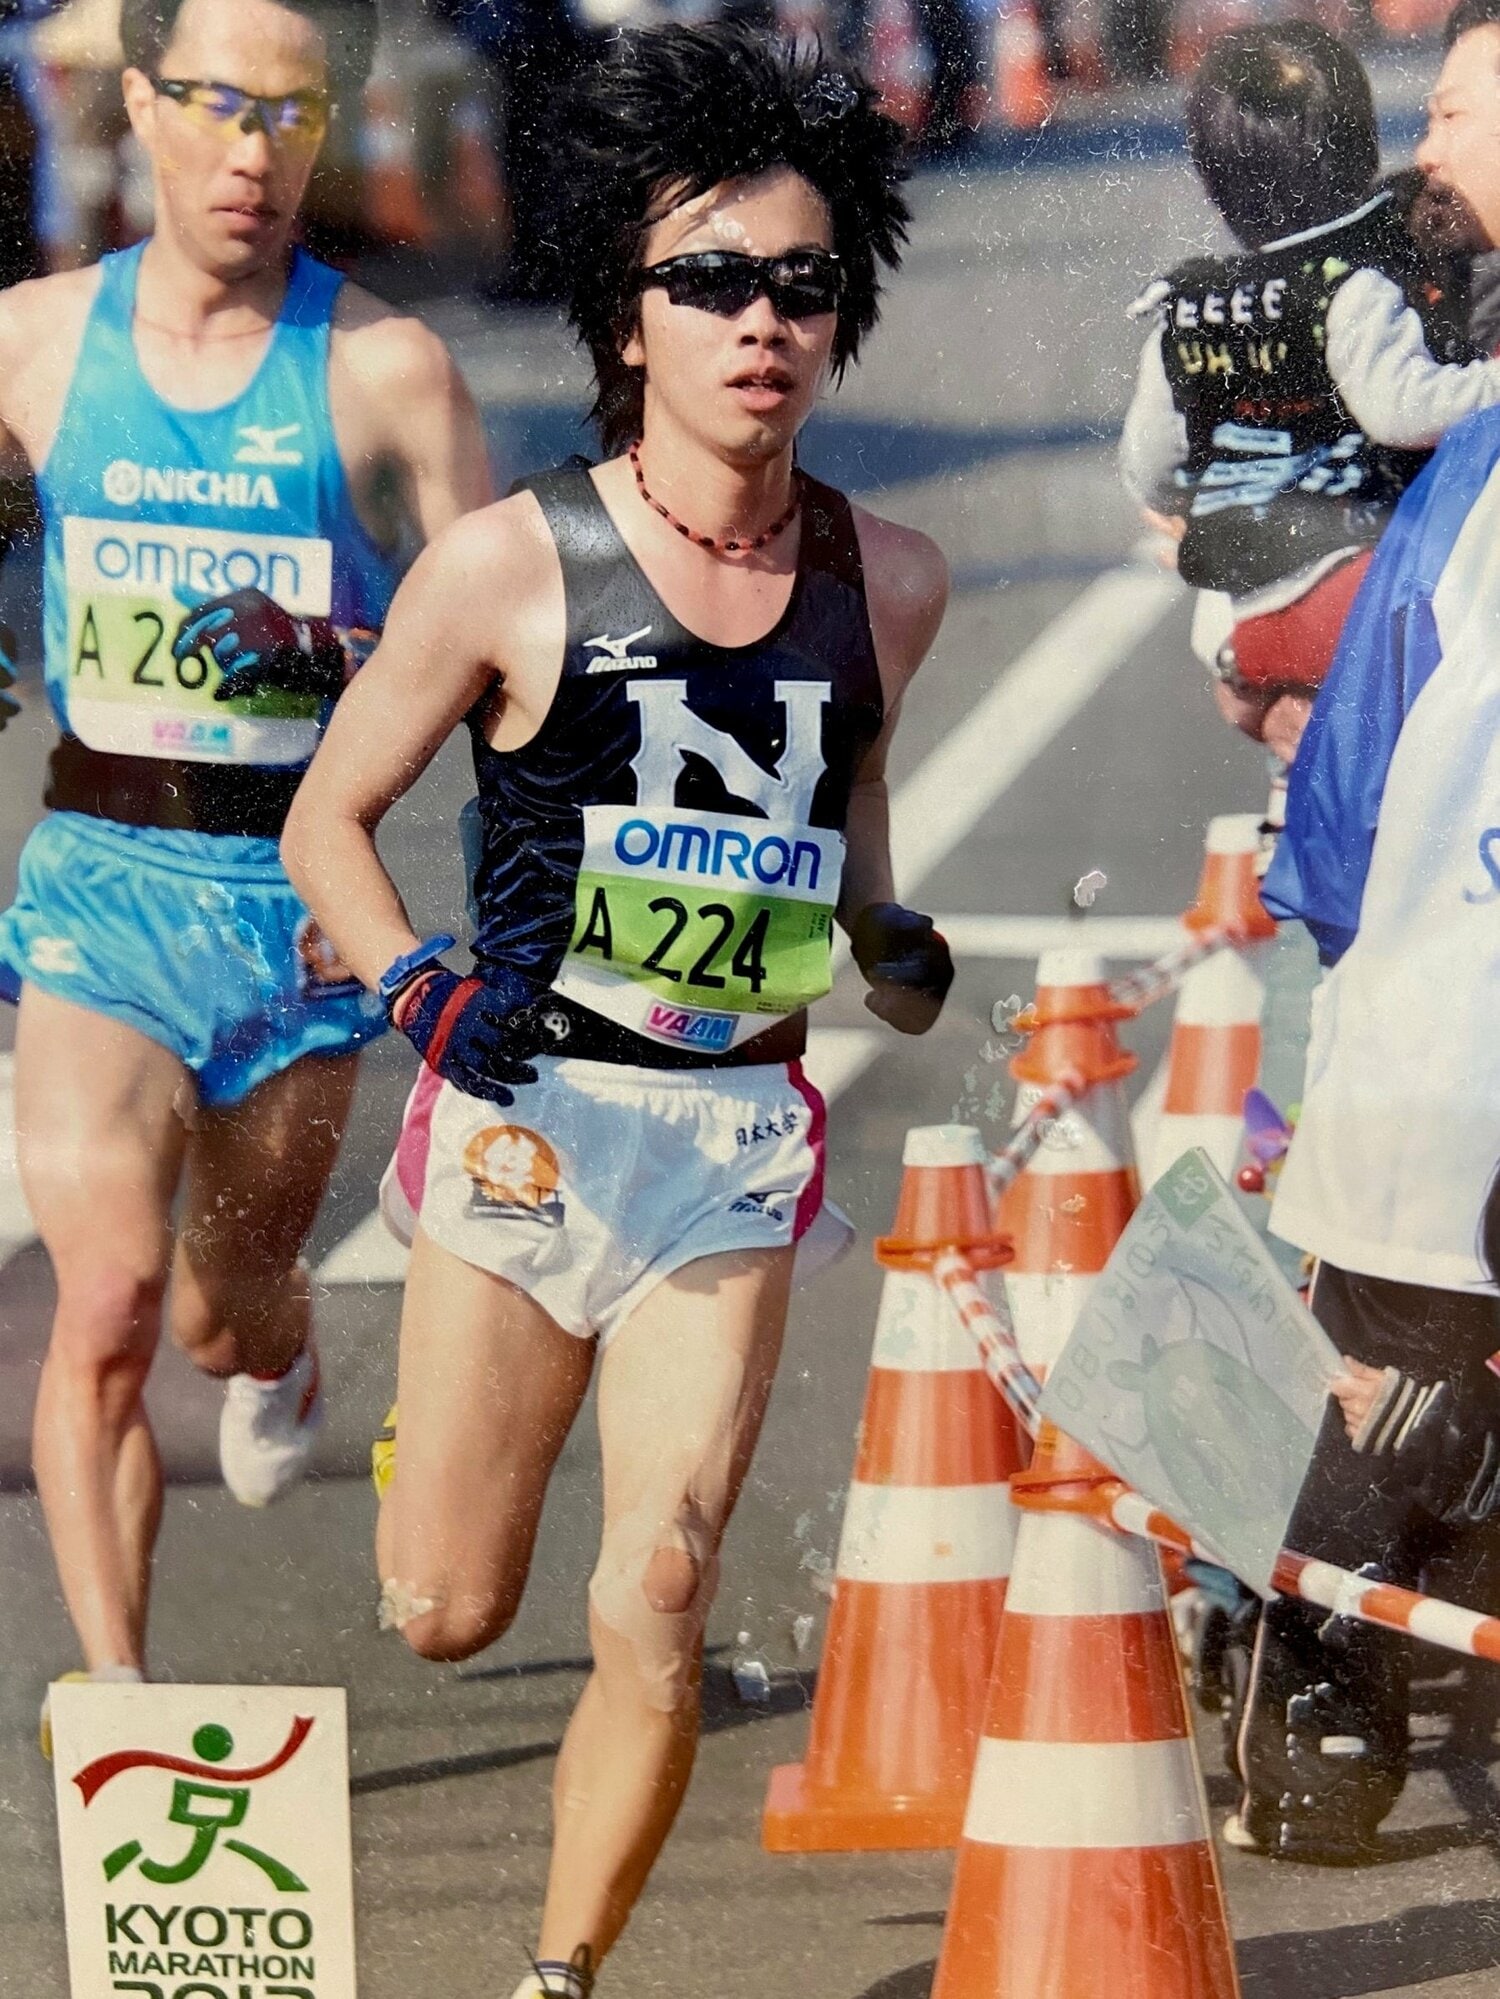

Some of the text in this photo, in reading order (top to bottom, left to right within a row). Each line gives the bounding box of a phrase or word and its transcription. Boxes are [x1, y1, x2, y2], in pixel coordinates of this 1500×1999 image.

[144, 467, 279, 509] NICHIA
[94, 537, 301, 596] OMRON
[75, 604, 105, 679] A
[614, 819, 822, 890] OMRON
[573, 887, 771, 993] A 224
[649, 1004, 734, 1045] VAAM
[735, 1111, 798, 1147] 日本大学
[105, 1903, 313, 1950] KYOTO
[108, 1950, 315, 1980] MARATHON
